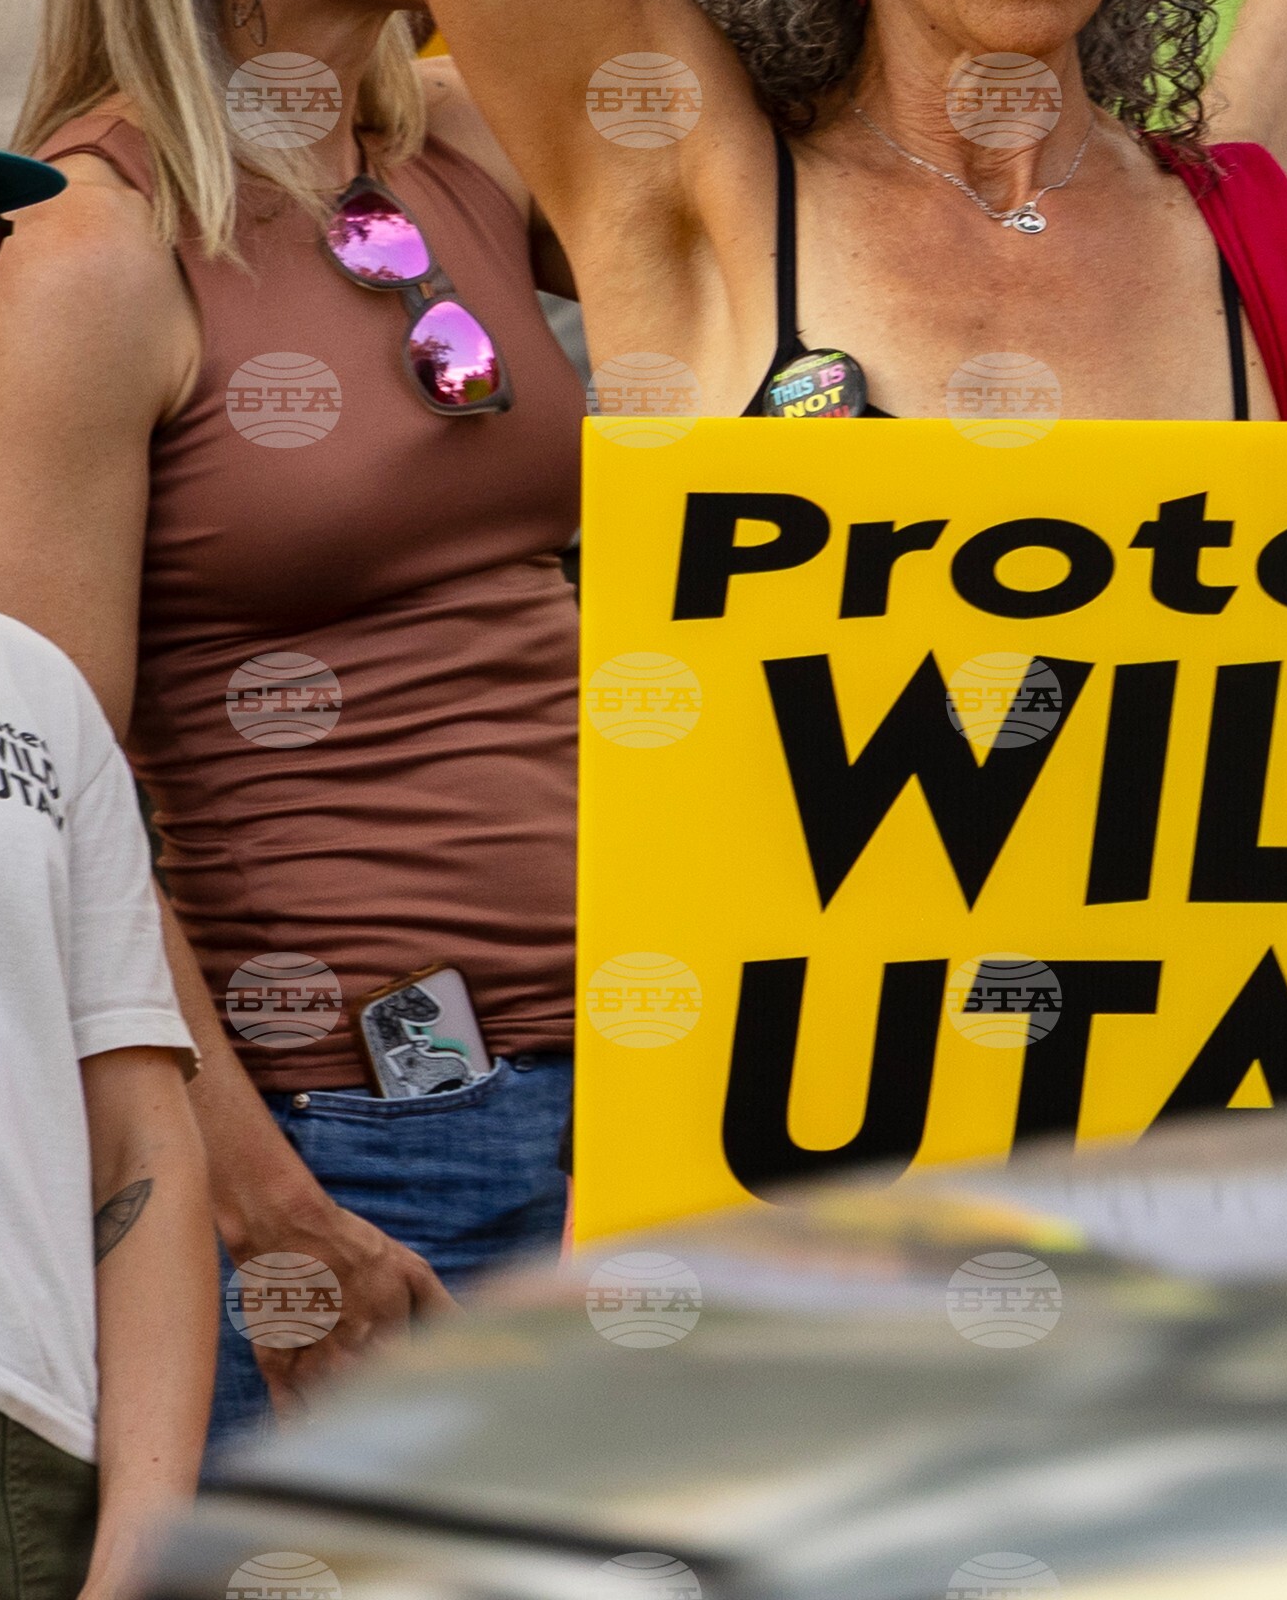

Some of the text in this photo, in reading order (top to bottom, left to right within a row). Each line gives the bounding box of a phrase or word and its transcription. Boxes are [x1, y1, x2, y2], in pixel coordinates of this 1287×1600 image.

[770, 375, 814, 406] THIS
[818, 362, 847, 388] IS
[782, 385, 845, 418] NOT
